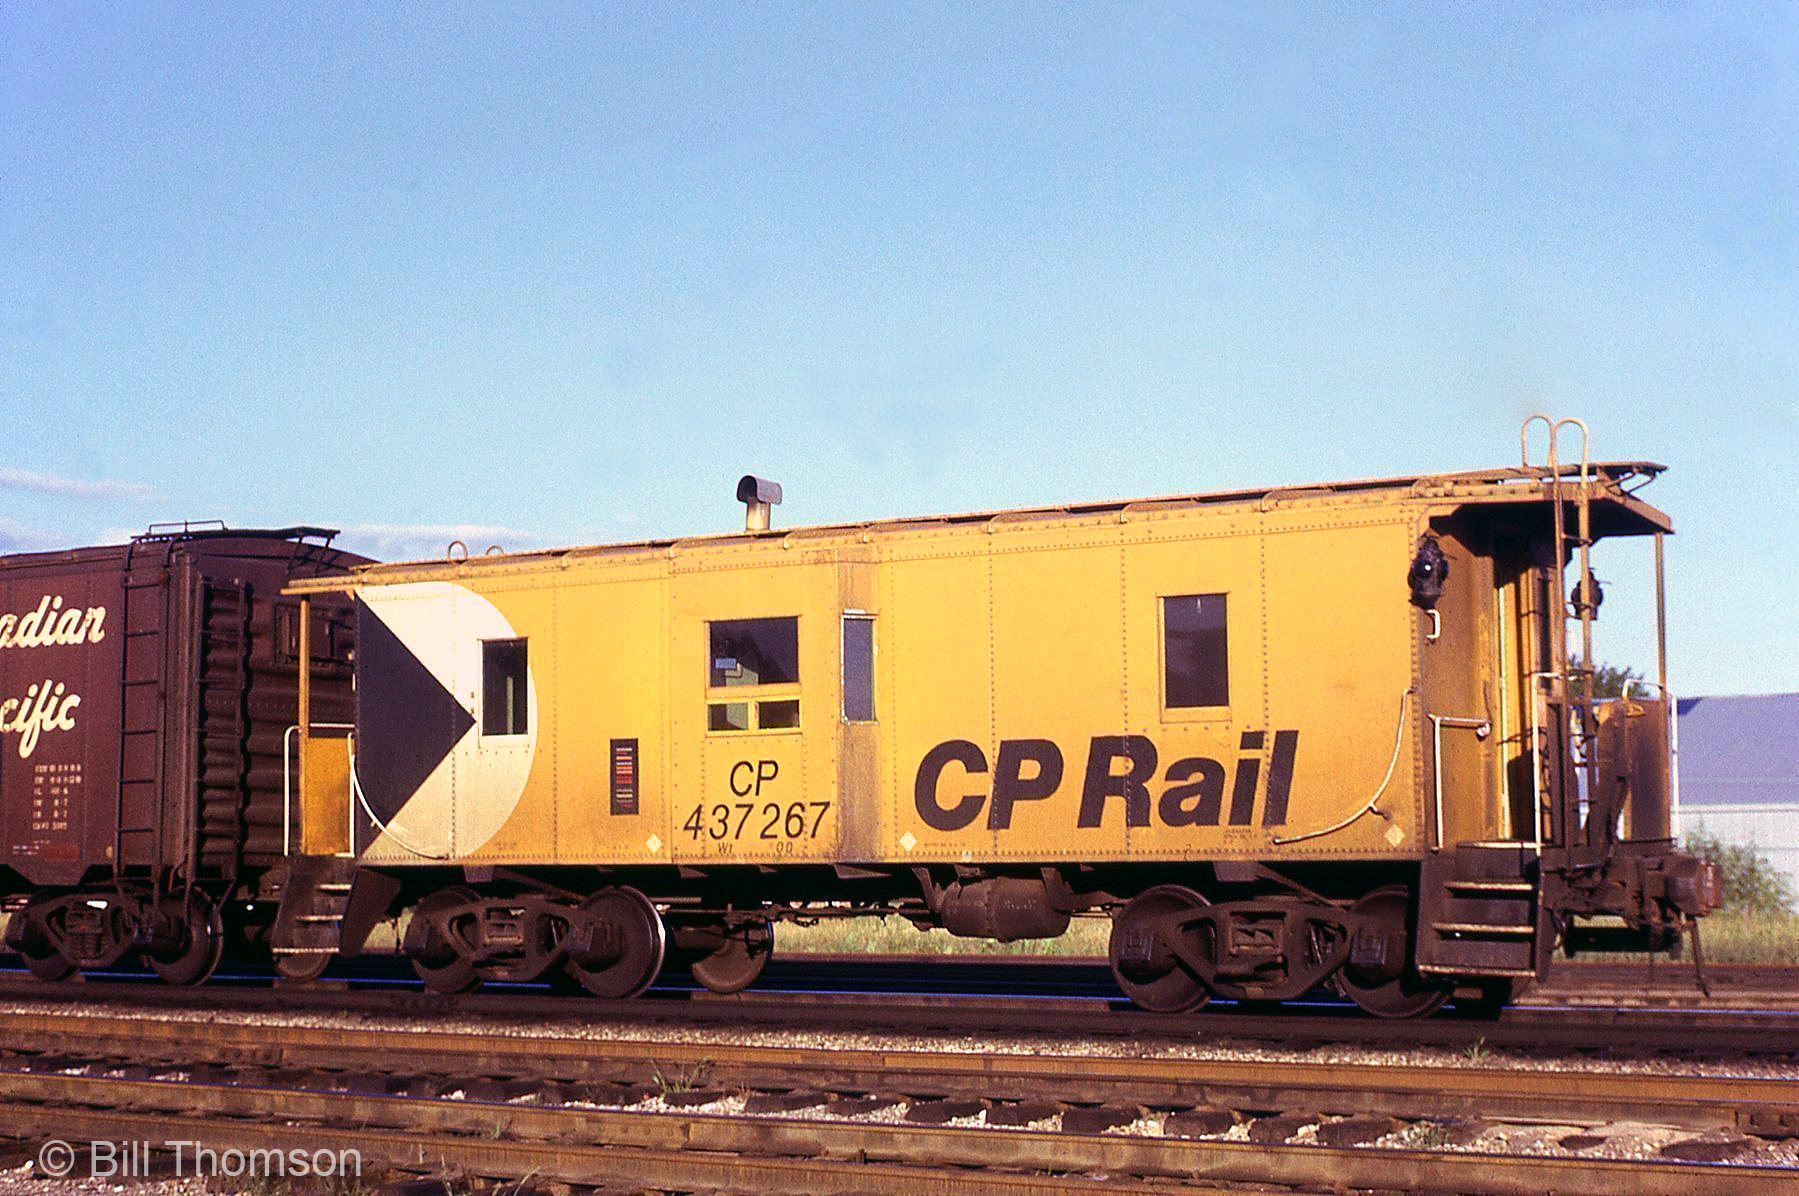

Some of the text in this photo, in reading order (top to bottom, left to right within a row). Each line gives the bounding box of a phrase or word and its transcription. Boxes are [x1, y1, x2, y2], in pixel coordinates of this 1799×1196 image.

[729, 760, 779, 797] CP
[914, 729, 1299, 831] CP Rail
